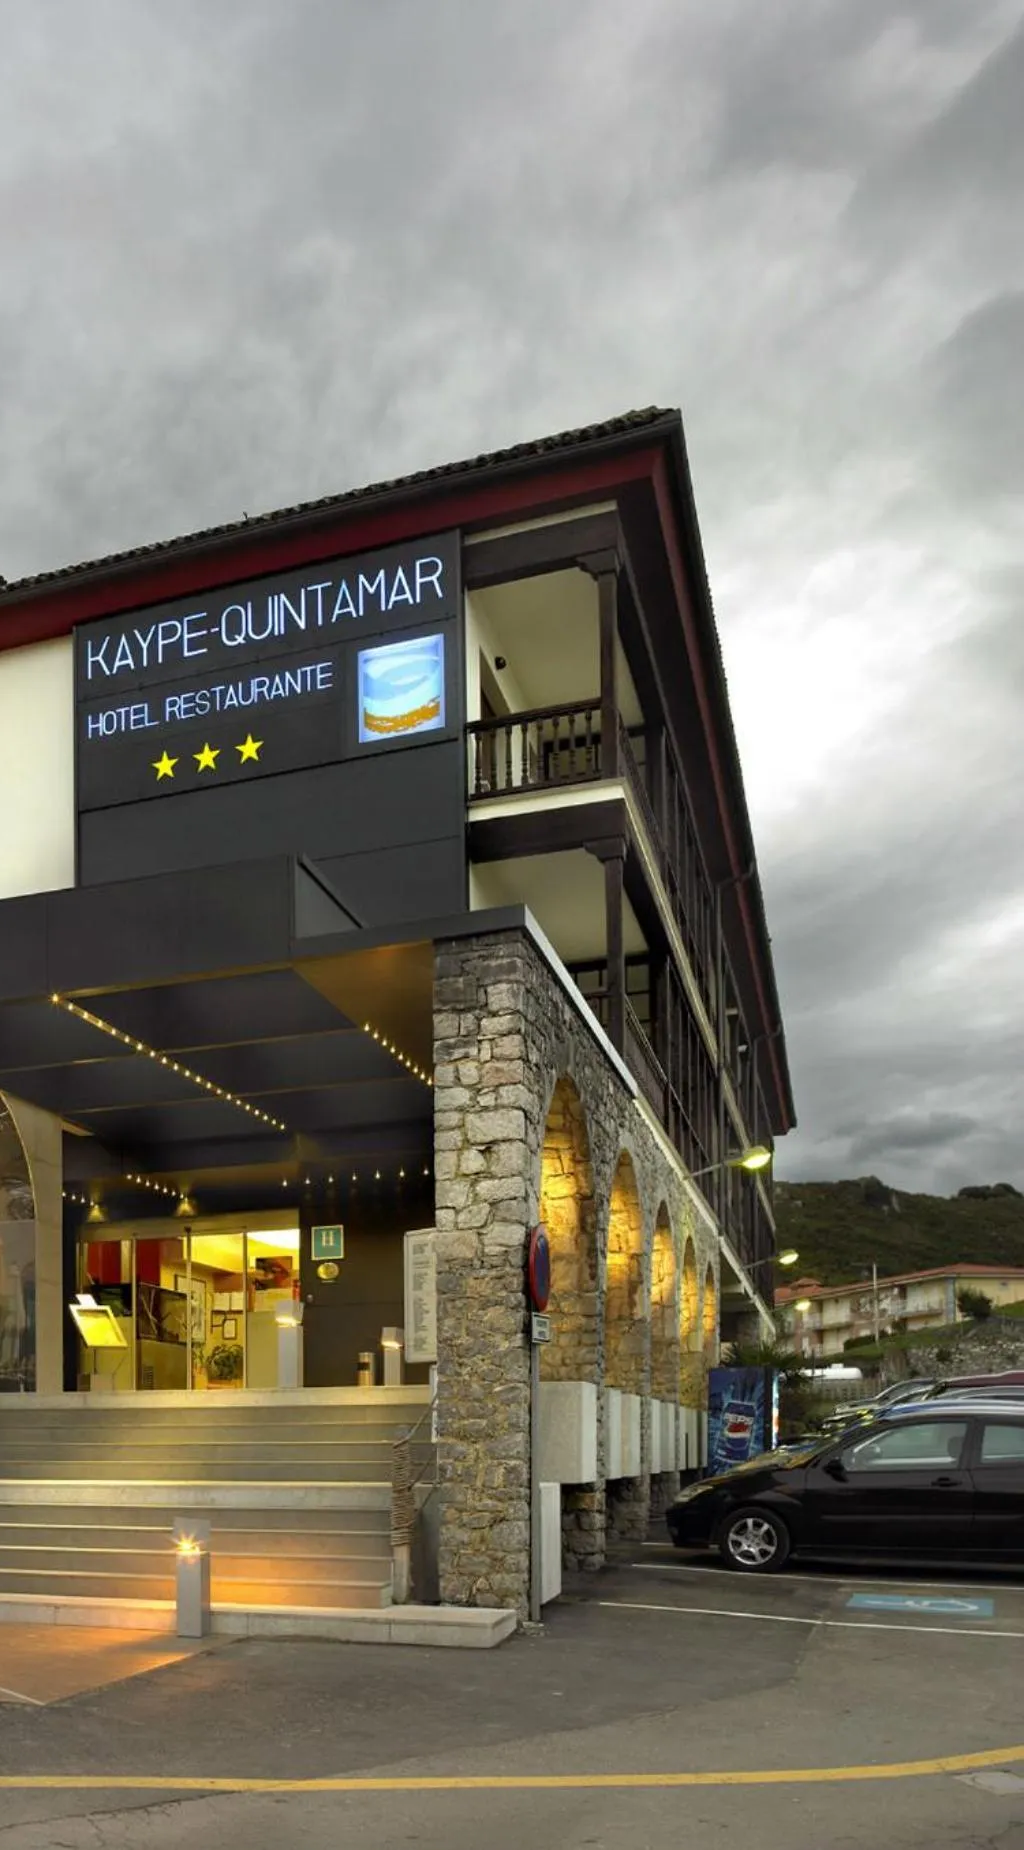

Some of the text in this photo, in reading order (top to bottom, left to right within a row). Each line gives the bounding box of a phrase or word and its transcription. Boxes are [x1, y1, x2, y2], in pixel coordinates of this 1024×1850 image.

[87, 556, 444, 680] KAYPE-QUINTAMAR
[87, 661, 334, 739] HOTEL RESTAURANTE
